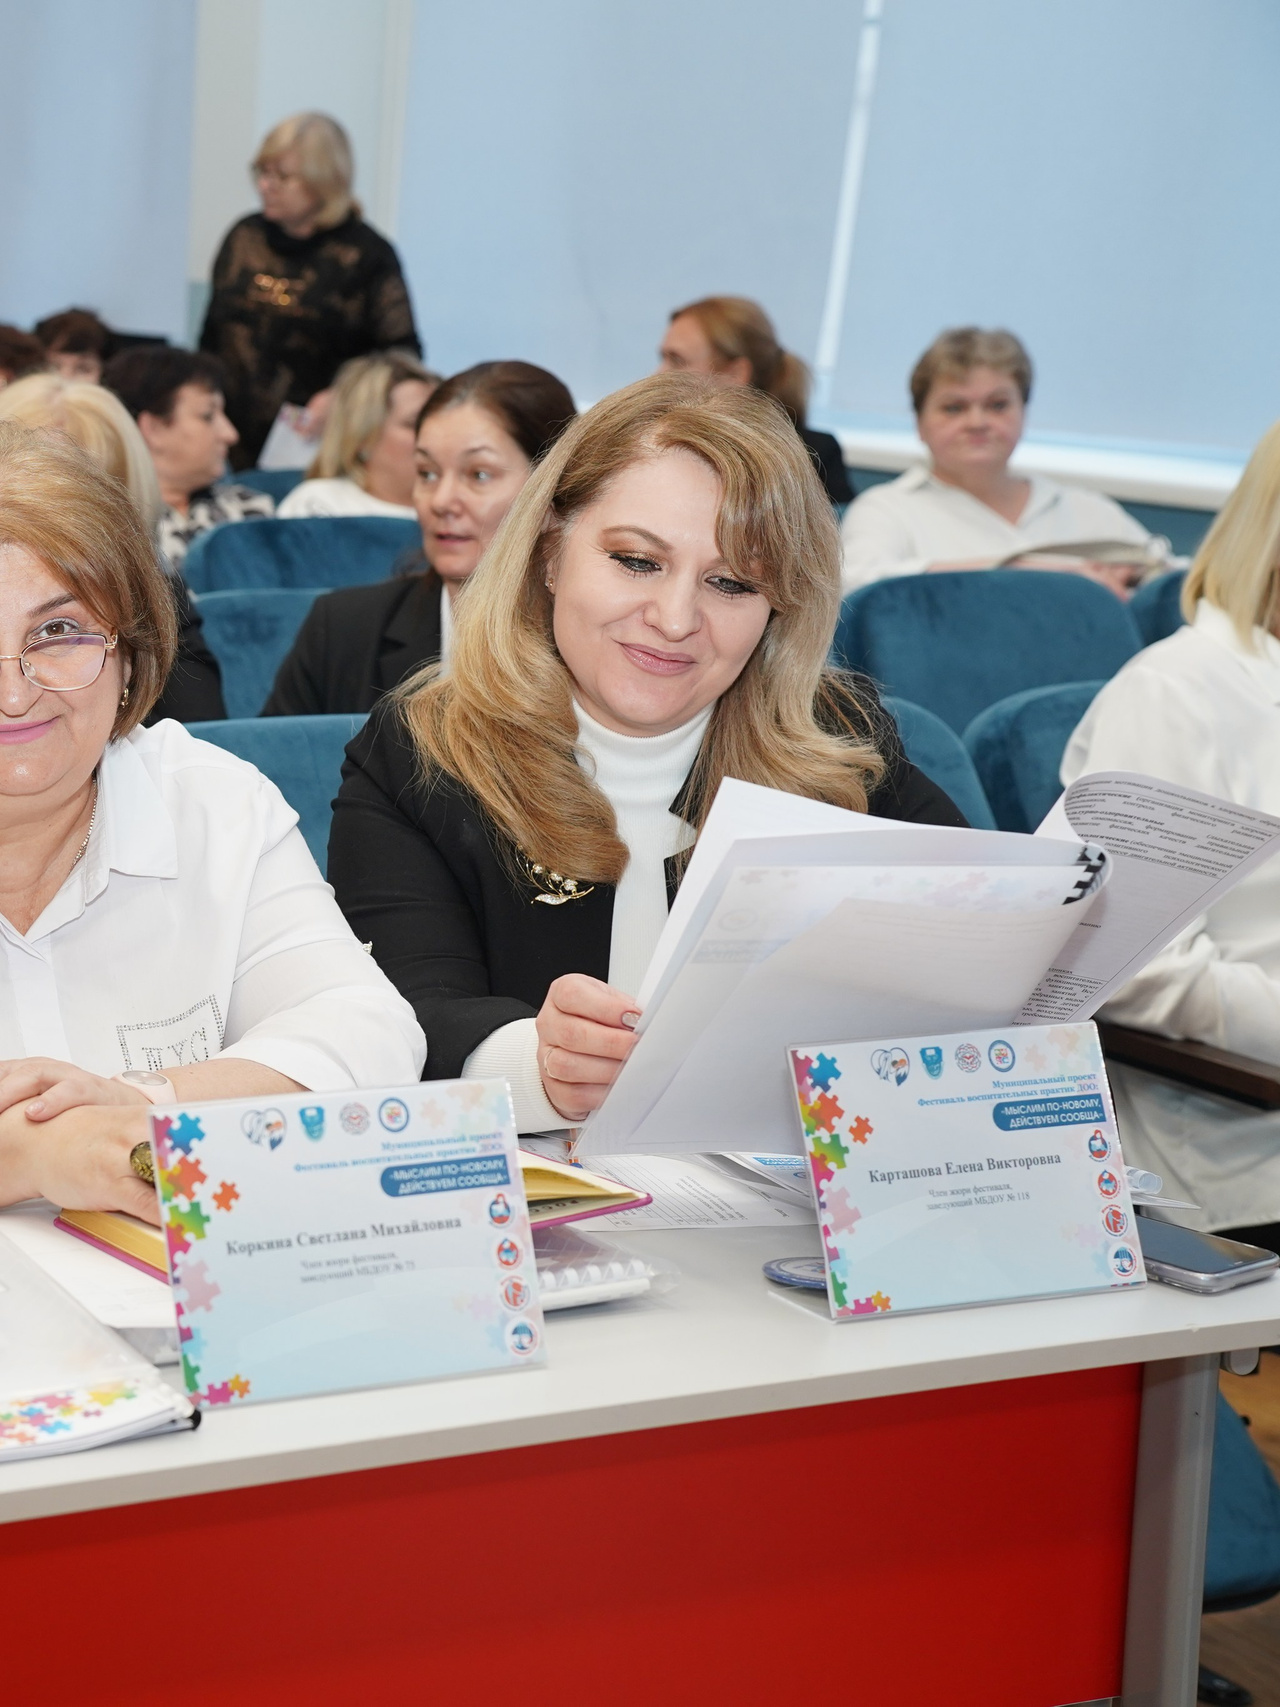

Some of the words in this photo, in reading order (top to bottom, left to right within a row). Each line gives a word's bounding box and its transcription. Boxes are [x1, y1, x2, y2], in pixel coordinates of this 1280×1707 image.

[1122, 801, 1155, 811] контроль
[1171, 811, 1217, 827] физического
[1109, 824, 1150, 835] физических
[1104, 842, 1148, 854] позитивного
[1163, 854, 1227, 874] психологического
[1179, 852, 1233, 869] эмоциональной
[1045, 978, 1099, 990] функционируют
[992, 1075, 1066, 1089] Муниципальный
[1068, 1073, 1097, 1083] проект
[918, 1095, 964, 1107] Фестиваль
[966, 1088, 1038, 1102] воспитательных
[1040, 1085, 1075, 1097] практик
[1077, 1082, 1099, 1094] ДОО:
[1001, 1102, 1046, 1116] «МЫСЛИМ
[1047, 1098, 1101, 1111] ПО-НОВОМУ,
[1009, 1112, 1059, 1128] ДЕЙСТВУЕМ
[1060, 1110, 1103, 1123] СООБЩА»
[381, 1135, 466, 1151] Муниципальный
[469, 1132, 504, 1143] проект
[294, 1159, 348, 1172] Фестиваль
[351, 1150, 434, 1166] воспитательных
[436, 1146, 476, 1159] практик
[868, 1165, 942, 1184] Карташова
[945, 1160, 984, 1175] Елена
[986, 1153, 1061, 1173] Викторовна
[398, 1177, 456, 1195] ДЕЙСТВУЕМ
[928, 1189, 948, 1198] Член
[949, 1187, 971, 1199] жюри
[973, 1182, 1013, 1195] фестиваля,
[926, 1198, 972, 1211] заведующий
[974, 1194, 1005, 1206] МБДОУ
[1007, 1193, 1015, 1202] №
[1017, 1191, 1030, 1201] 118
[226, 1239, 292, 1256] Коркина
[296, 1229, 367, 1247] Светлана
[370, 1217, 462, 1238] Михайловна
[299, 1259, 322, 1269] Член
[324, 1257, 350, 1270] жюри
[300, 1269, 354, 1284] заведующий
[355, 1264, 391, 1277] МБДОУ
